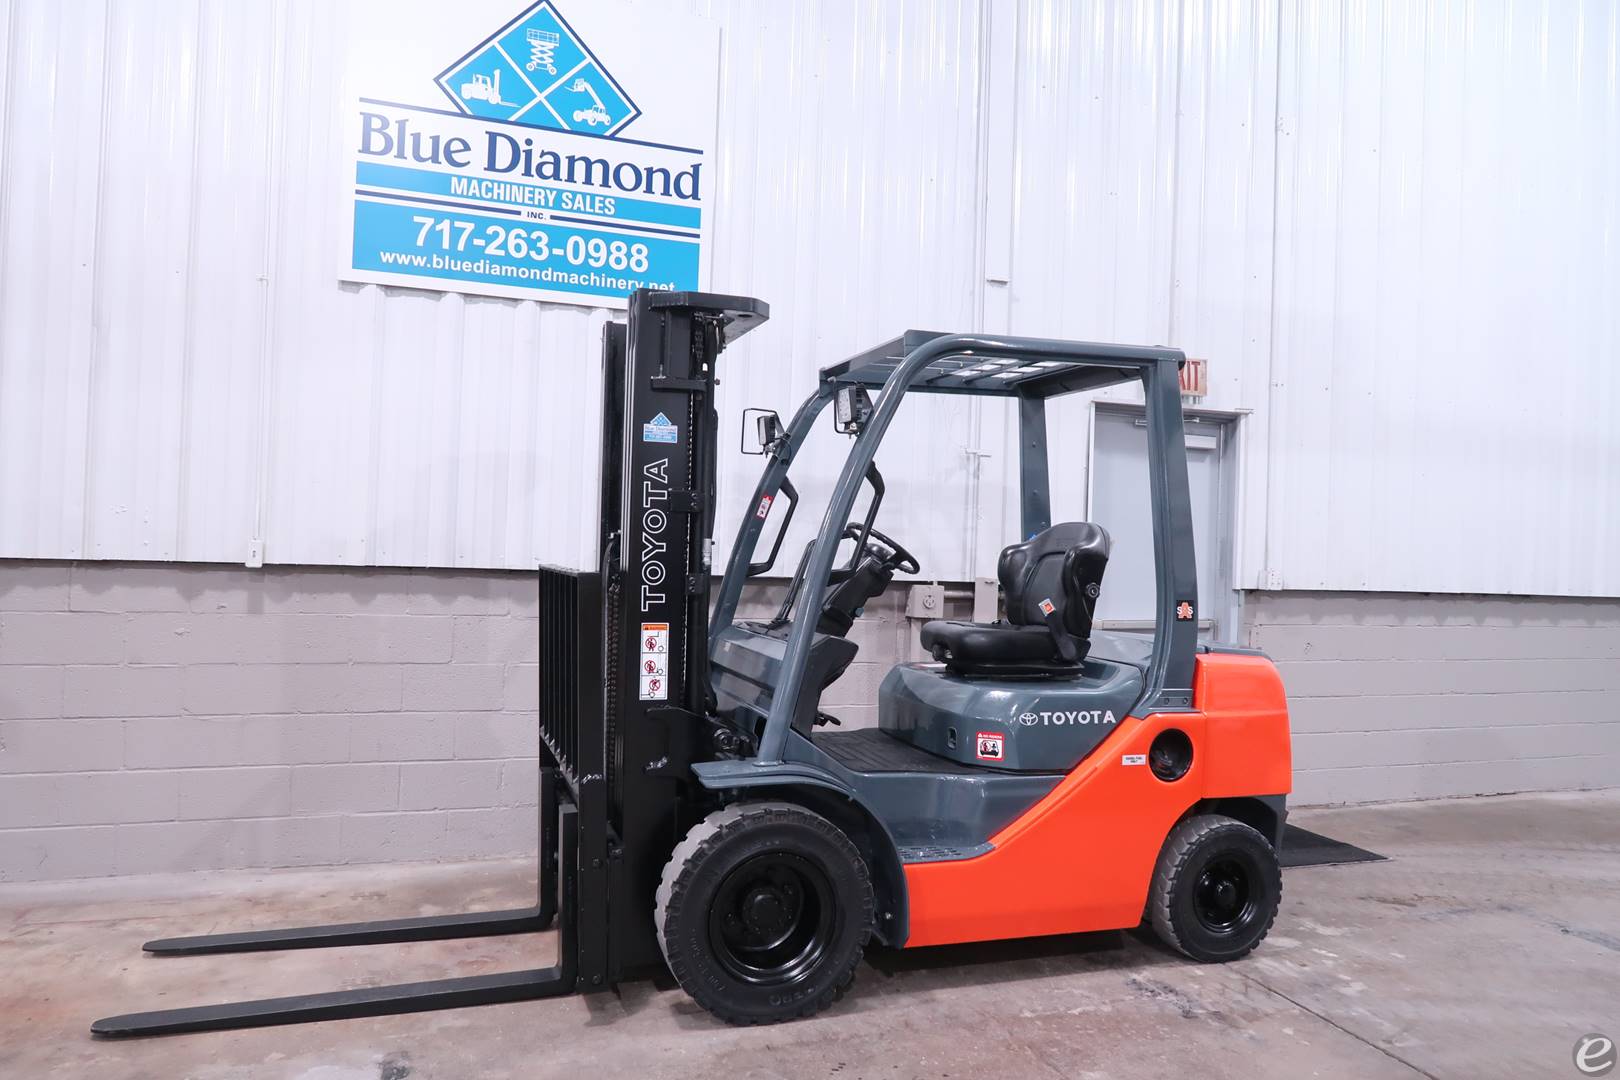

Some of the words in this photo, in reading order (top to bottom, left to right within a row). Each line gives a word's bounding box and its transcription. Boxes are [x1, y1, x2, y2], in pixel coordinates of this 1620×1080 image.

[358, 111, 471, 168] Blue
[483, 130, 703, 201] Diamond
[450, 176, 556, 209] MACHINERY
[561, 190, 616, 215] SALES
[526, 210, 547, 221] INC.
[413, 215, 649, 273] 717-263-0988
[379, 249, 676, 291] www.bluediamondmachinerynet
[1179, 360, 1201, 391] IT
[641, 457, 669, 612] TOYOTA
[1040, 710, 1117, 726] TOYOTA
